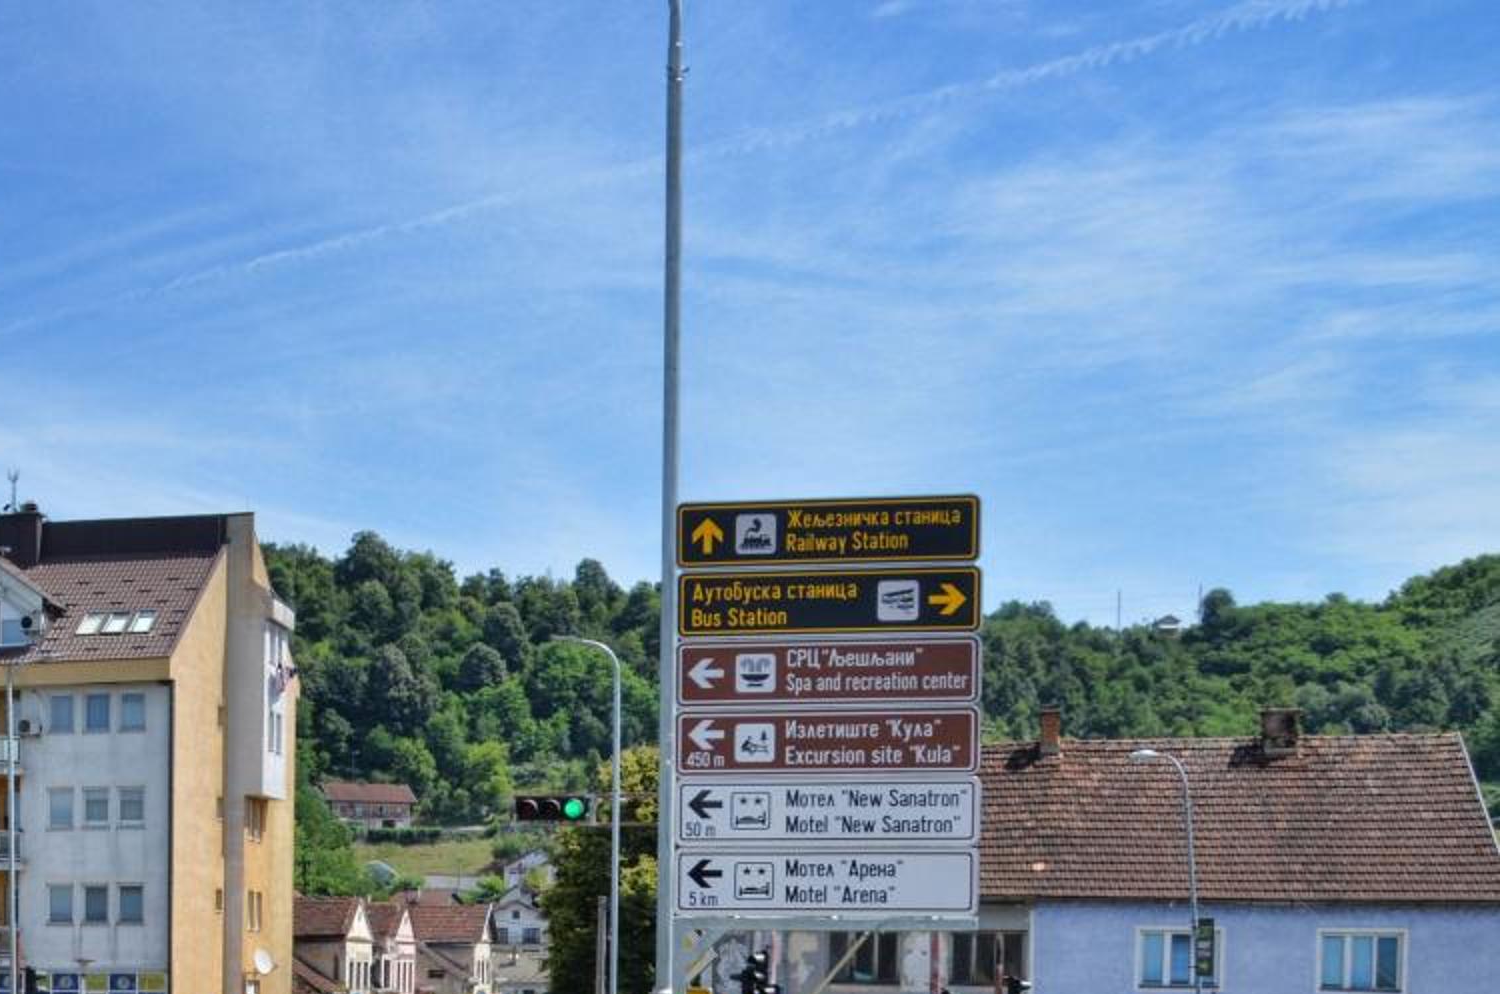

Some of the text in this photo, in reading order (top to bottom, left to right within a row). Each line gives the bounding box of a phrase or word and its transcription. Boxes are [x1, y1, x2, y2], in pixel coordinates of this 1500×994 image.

[787, 508, 961, 528] Жељезничка станица
[786, 532, 908, 554] Railway Station
[692, 580, 858, 604] Аутобуска станица
[691, 607, 787, 627] Bus Station
[786, 668, 968, 693] Spa and recreation center
[786, 719, 941, 740] Излетиште "Кула"
[713, 755, 725, 767] m
[786, 745, 960, 766] Excursion site "Kula"
[786, 789, 968, 808] Мотел "New Sanatron"
[685, 823, 716, 837] 50 m
[786, 815, 961, 833] Motel "New Sanatron"
[786, 859, 904, 881] Мотел "Арена"
[689, 892, 718, 906] 5 km
[786, 885, 896, 904] Motel "Arena"
